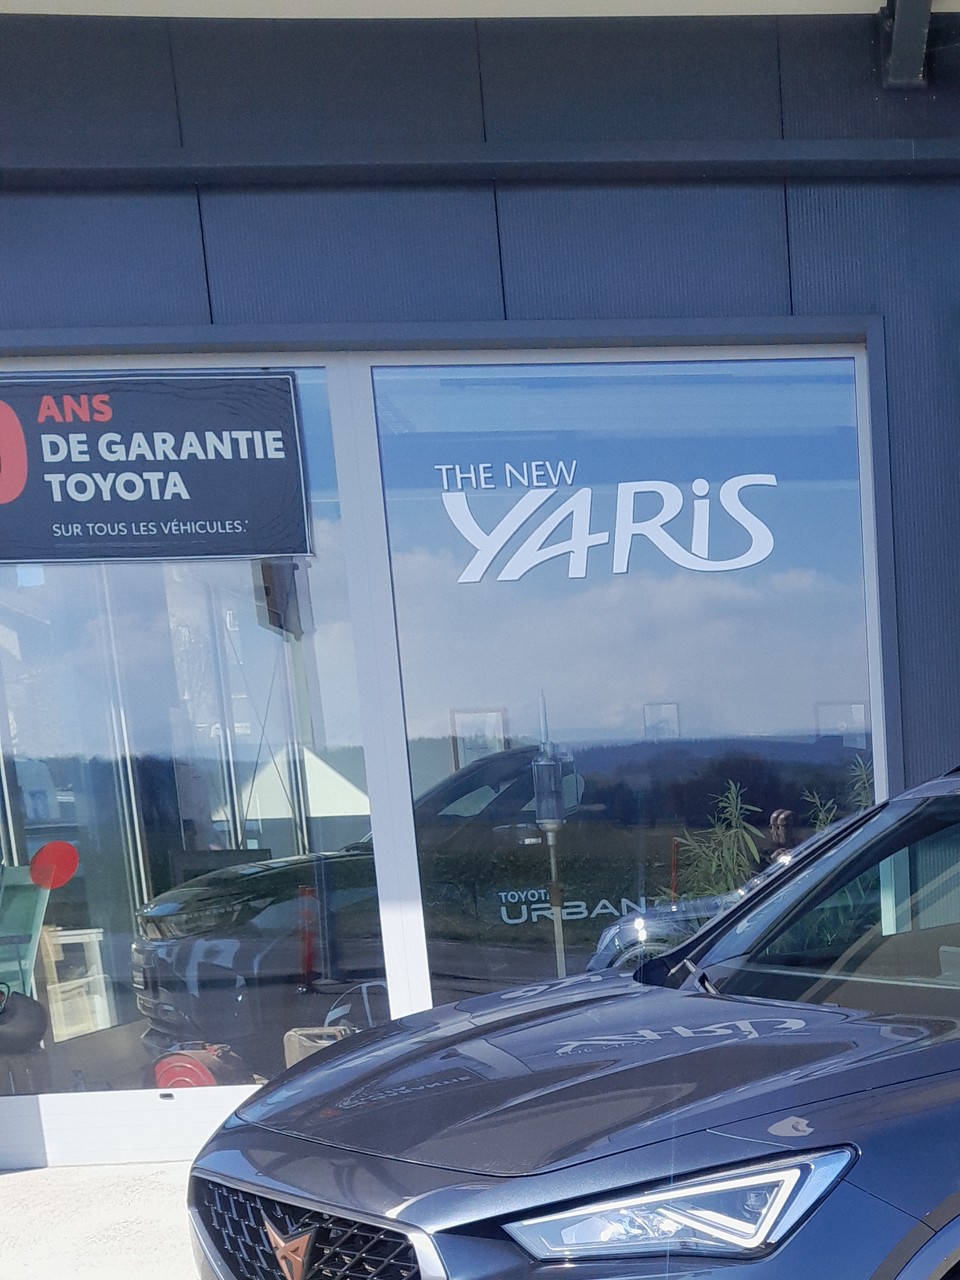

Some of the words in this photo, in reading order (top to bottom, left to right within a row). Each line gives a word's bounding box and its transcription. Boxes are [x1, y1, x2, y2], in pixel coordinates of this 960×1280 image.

[37, 394, 113, 423] ANS
[41, 433, 91, 462] DE
[98, 430, 286, 461] GARANTIE
[44, 471, 190, 502] TOYOTA
[434, 463, 496, 490] THE
[505, 460, 577, 487] NEW
[53, 523, 83, 537] SUR
[86, 522, 128, 536] TOUS
[132, 521, 157, 535] LES
[499, 889, 550, 904] TOYOT
[501, 896, 647, 925] URBAN
